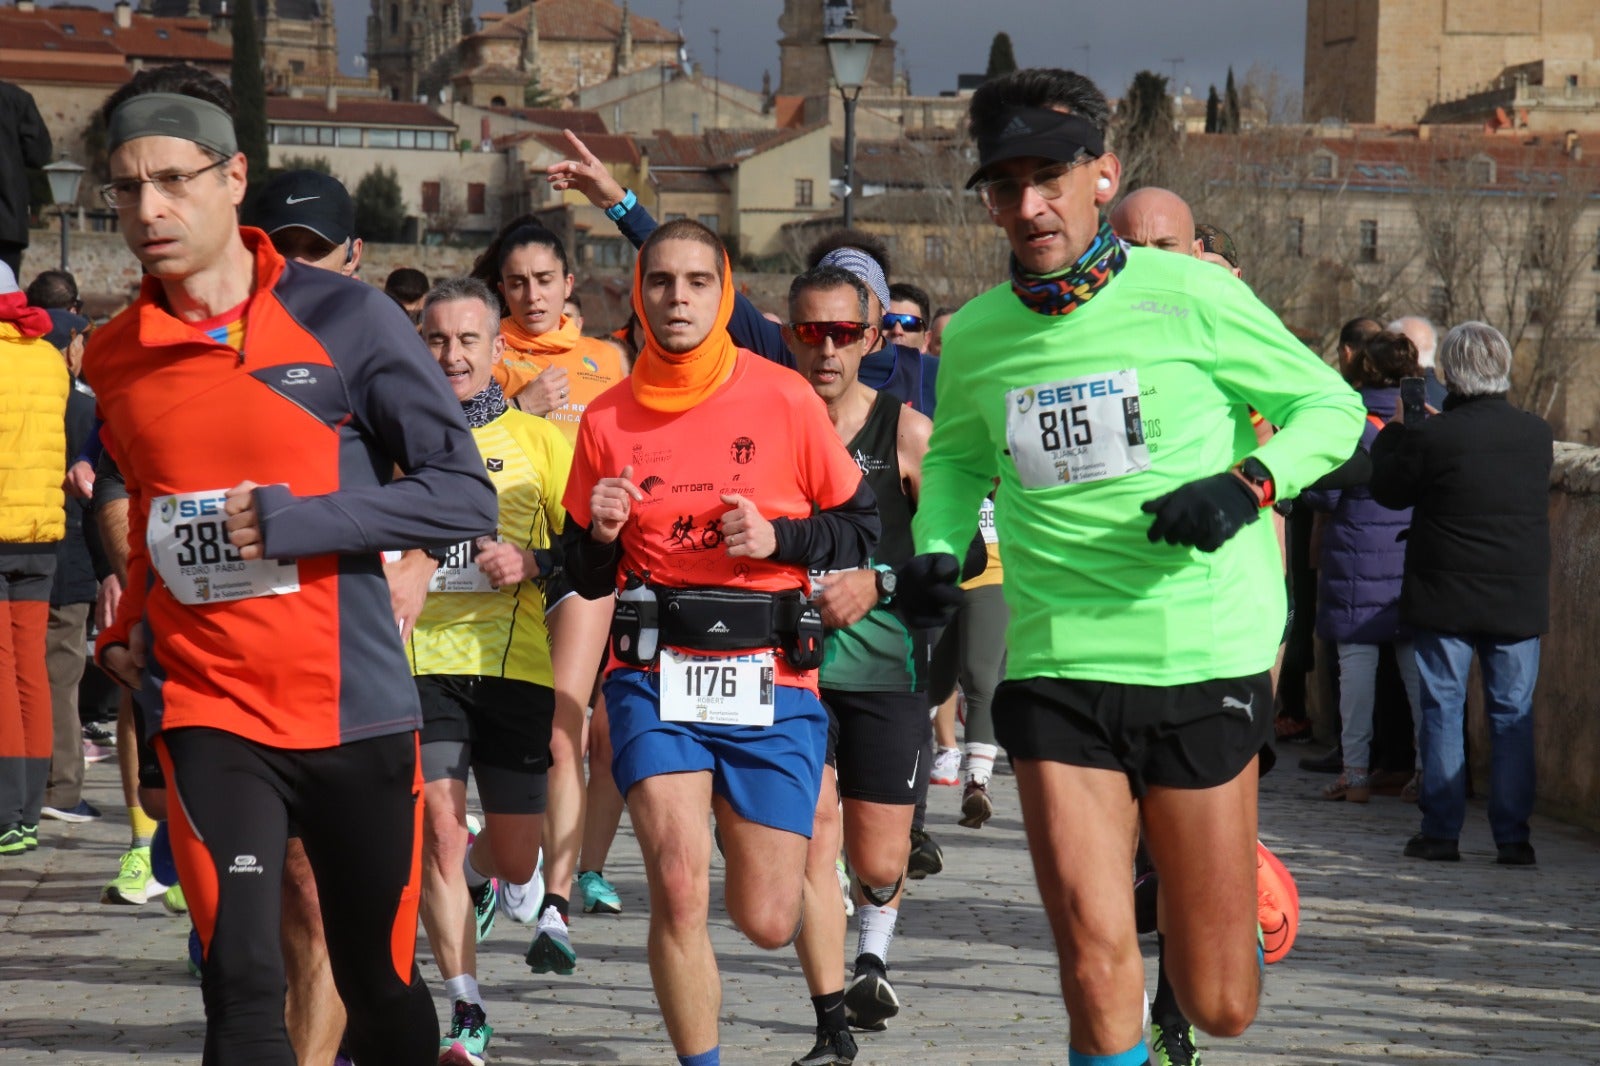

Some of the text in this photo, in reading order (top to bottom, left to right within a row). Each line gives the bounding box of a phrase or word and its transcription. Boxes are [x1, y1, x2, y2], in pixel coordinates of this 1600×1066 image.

[1038, 379, 1124, 406] SETEL
[1039, 405, 1092, 451] 815
[672, 485, 690, 494] NTT
[180, 562, 246, 576] PEDRO PABLO
[685, 665, 737, 697] 1176
